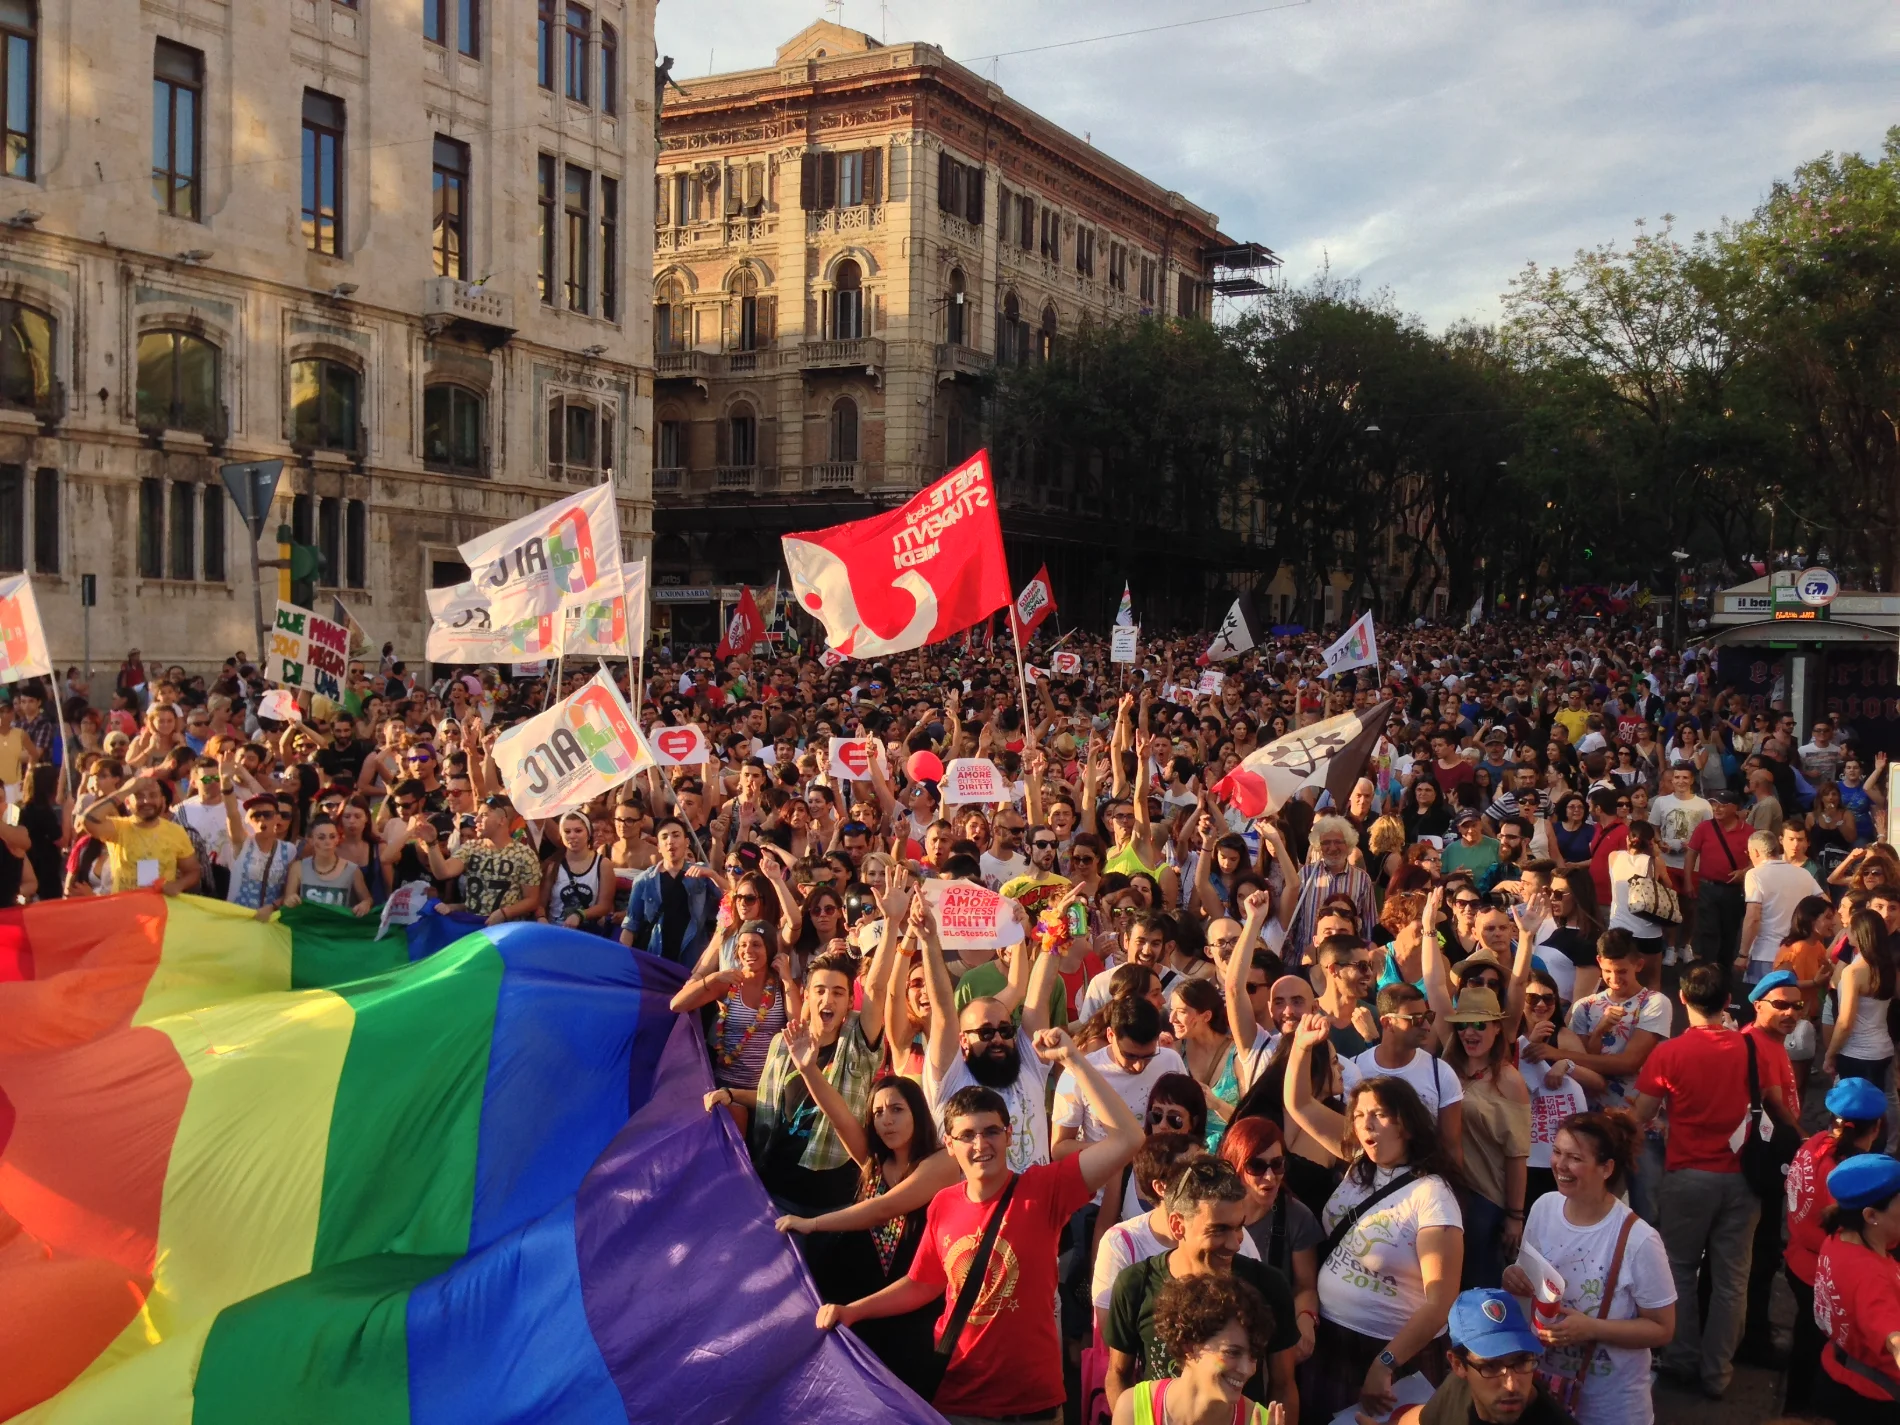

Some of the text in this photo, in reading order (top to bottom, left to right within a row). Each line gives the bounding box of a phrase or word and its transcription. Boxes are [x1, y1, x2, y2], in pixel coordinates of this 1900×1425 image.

[686, 589, 710, 597] SARDA
[1738, 598, 1746, 606] il
[277, 608, 306, 636] DUE
[271, 634, 346, 678] SONO MEGLIO
[282, 658, 304, 686] DI
[314, 668, 340, 702] UNA
[1619, 722, 1636, 734] Old
[468, 854, 514, 876] BAD
[468, 876, 511, 914] 87
[945, 895, 999, 907] AMORE
[943, 907, 996, 915] GLI STESSI
[942, 916, 996, 927] DIRITTI
[1537, 1096, 1549, 1144] AMORE
[1530, 1132, 1538, 1144] LO
[1342, 1268, 1398, 1297] 2015
